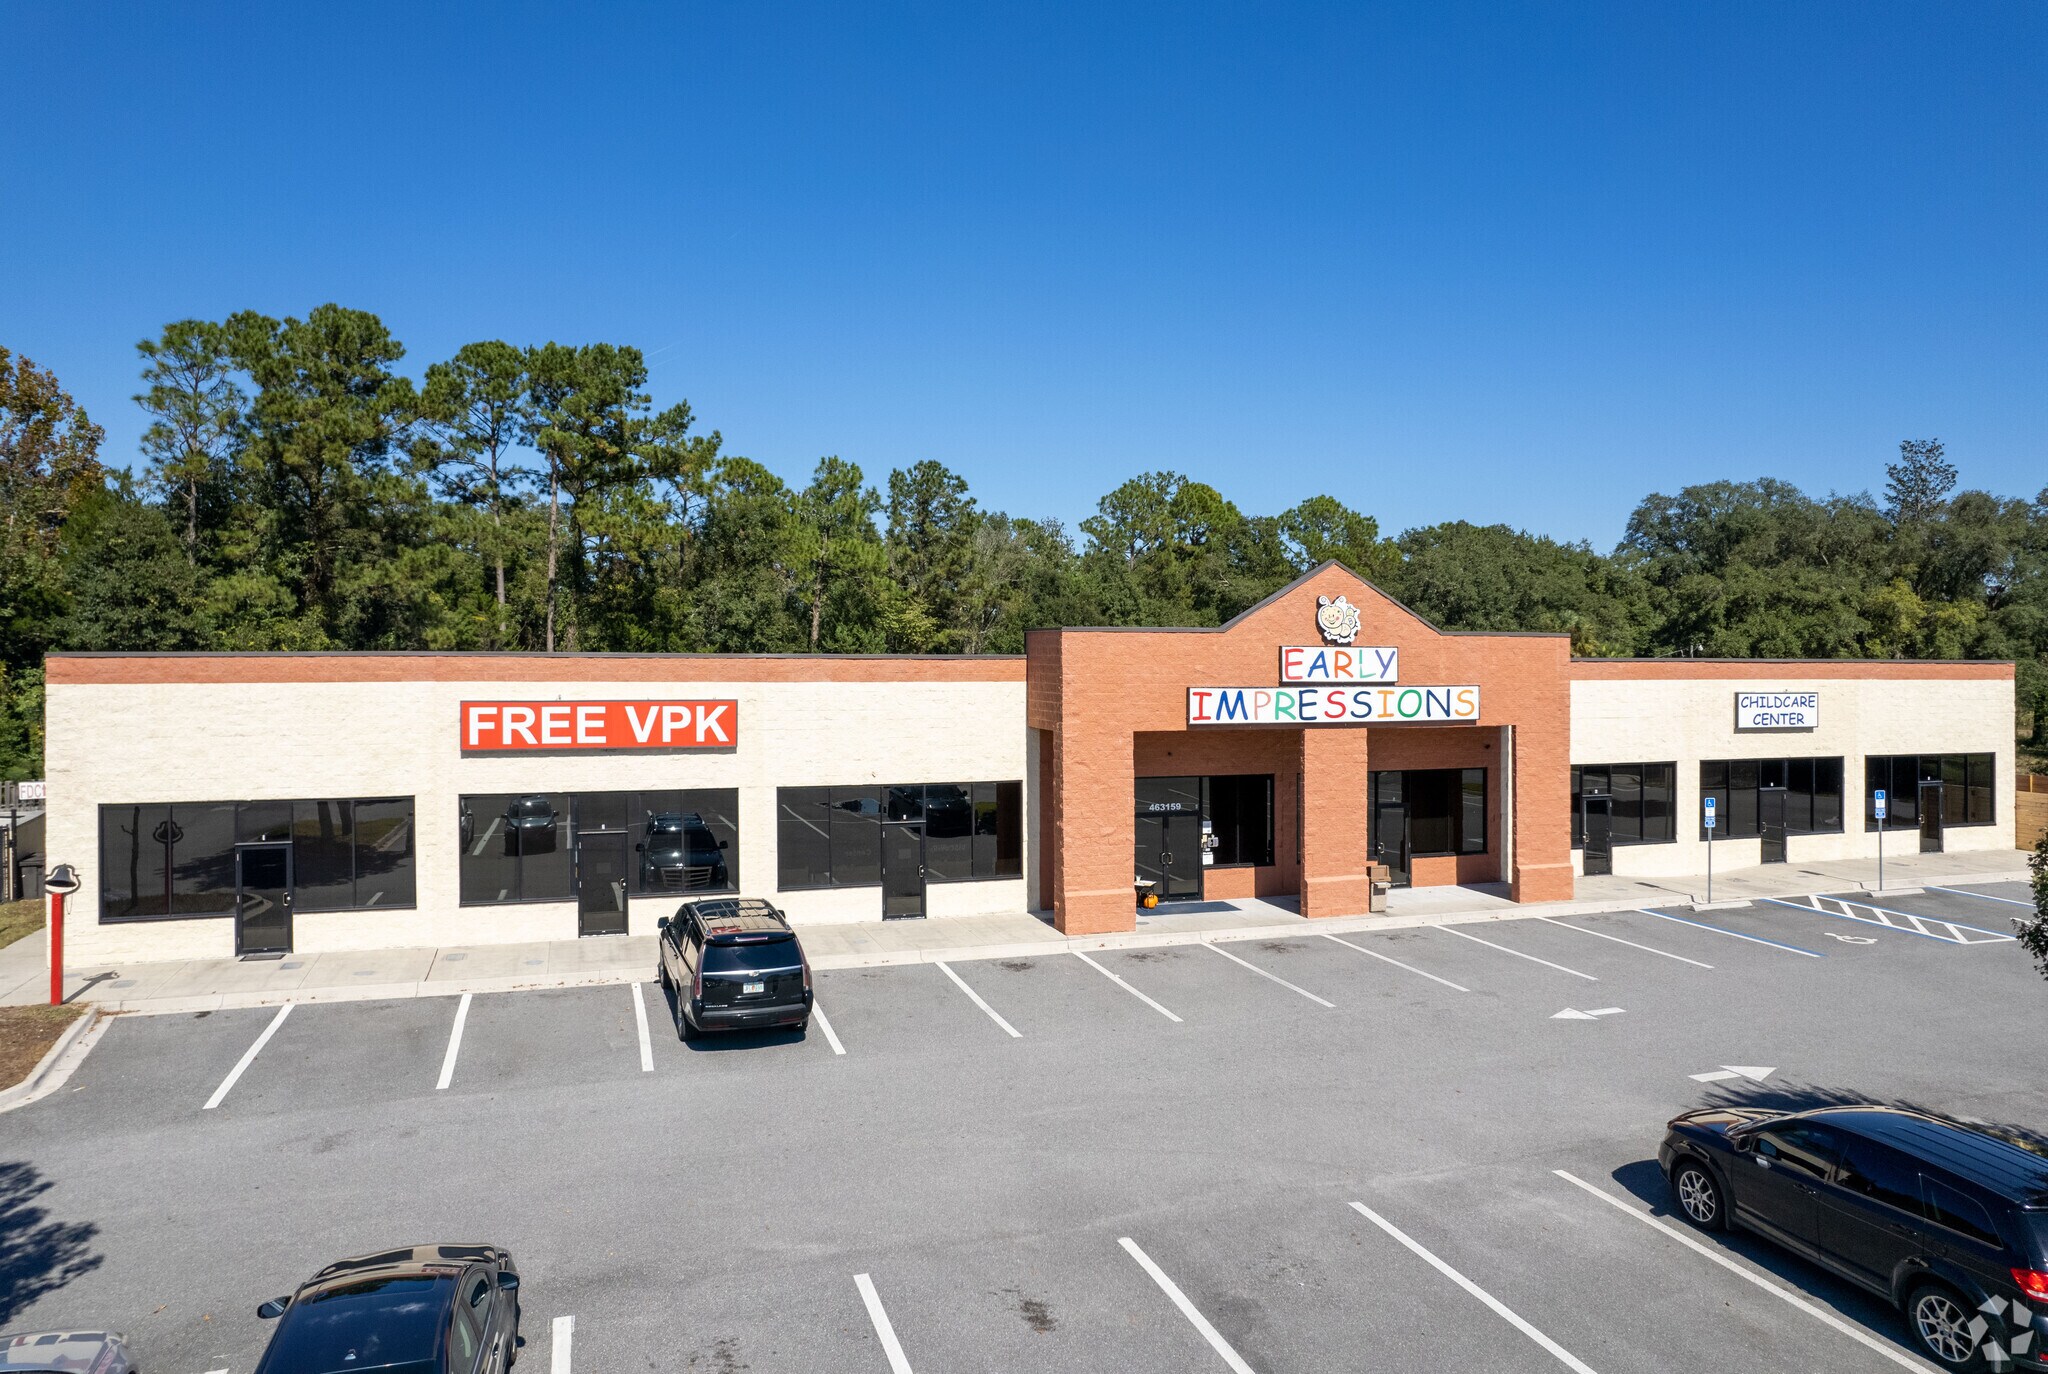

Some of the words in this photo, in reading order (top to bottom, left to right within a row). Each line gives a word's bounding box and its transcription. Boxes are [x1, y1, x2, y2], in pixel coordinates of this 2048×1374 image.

[1284, 648, 1396, 680] EARLY
[1191, 688, 1476, 721] IMPRESSIONS
[1740, 695, 1816, 708] CHILDCARE
[468, 705, 607, 746] FREE
[624, 705, 730, 743] VPK
[1752, 712, 1805, 725] CENTER
[20, 784, 42, 798] FDC
[1148, 802, 1182, 812] 463159
